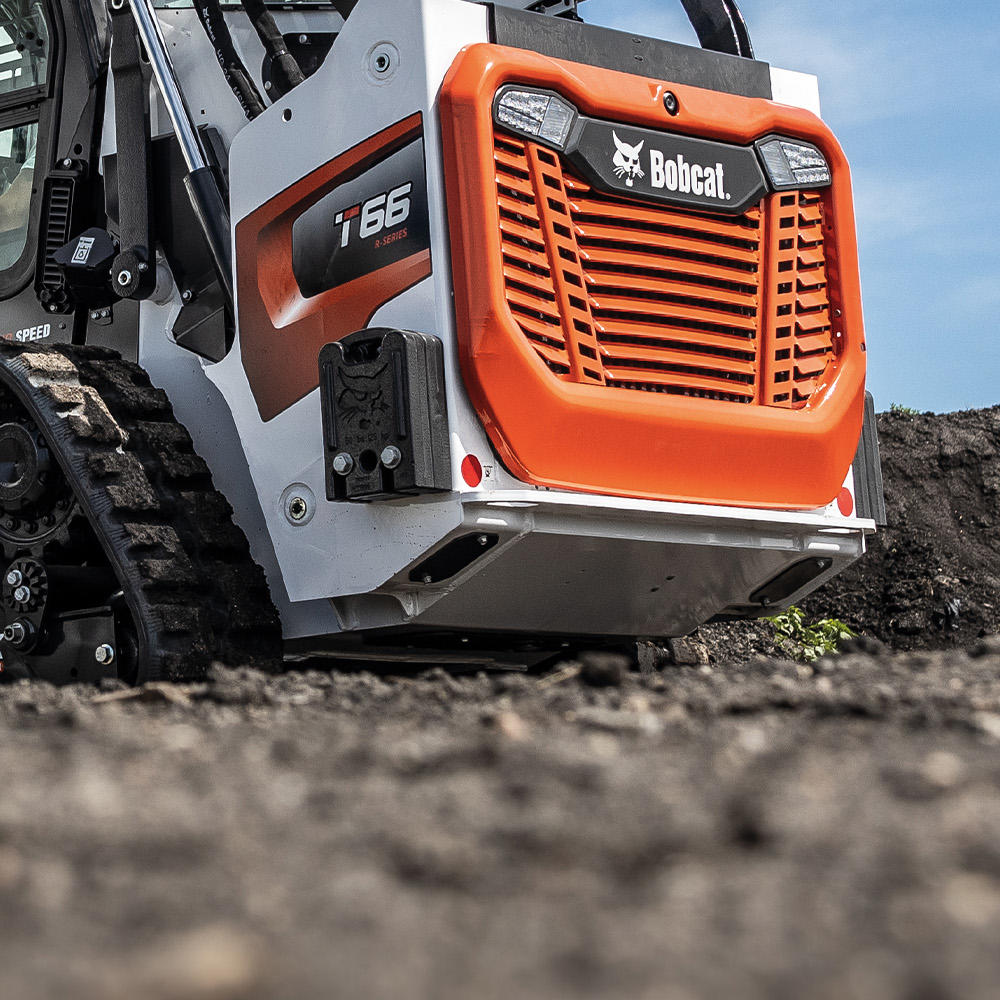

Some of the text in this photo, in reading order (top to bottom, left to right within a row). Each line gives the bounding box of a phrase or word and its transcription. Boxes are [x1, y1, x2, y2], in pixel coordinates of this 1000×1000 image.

[650, 150, 725, 200] Bobcat
[335, 183, 412, 248] T66
[375, 228, 408, 248] R-SERIES
[15, 323, 51, 342] SPEED
